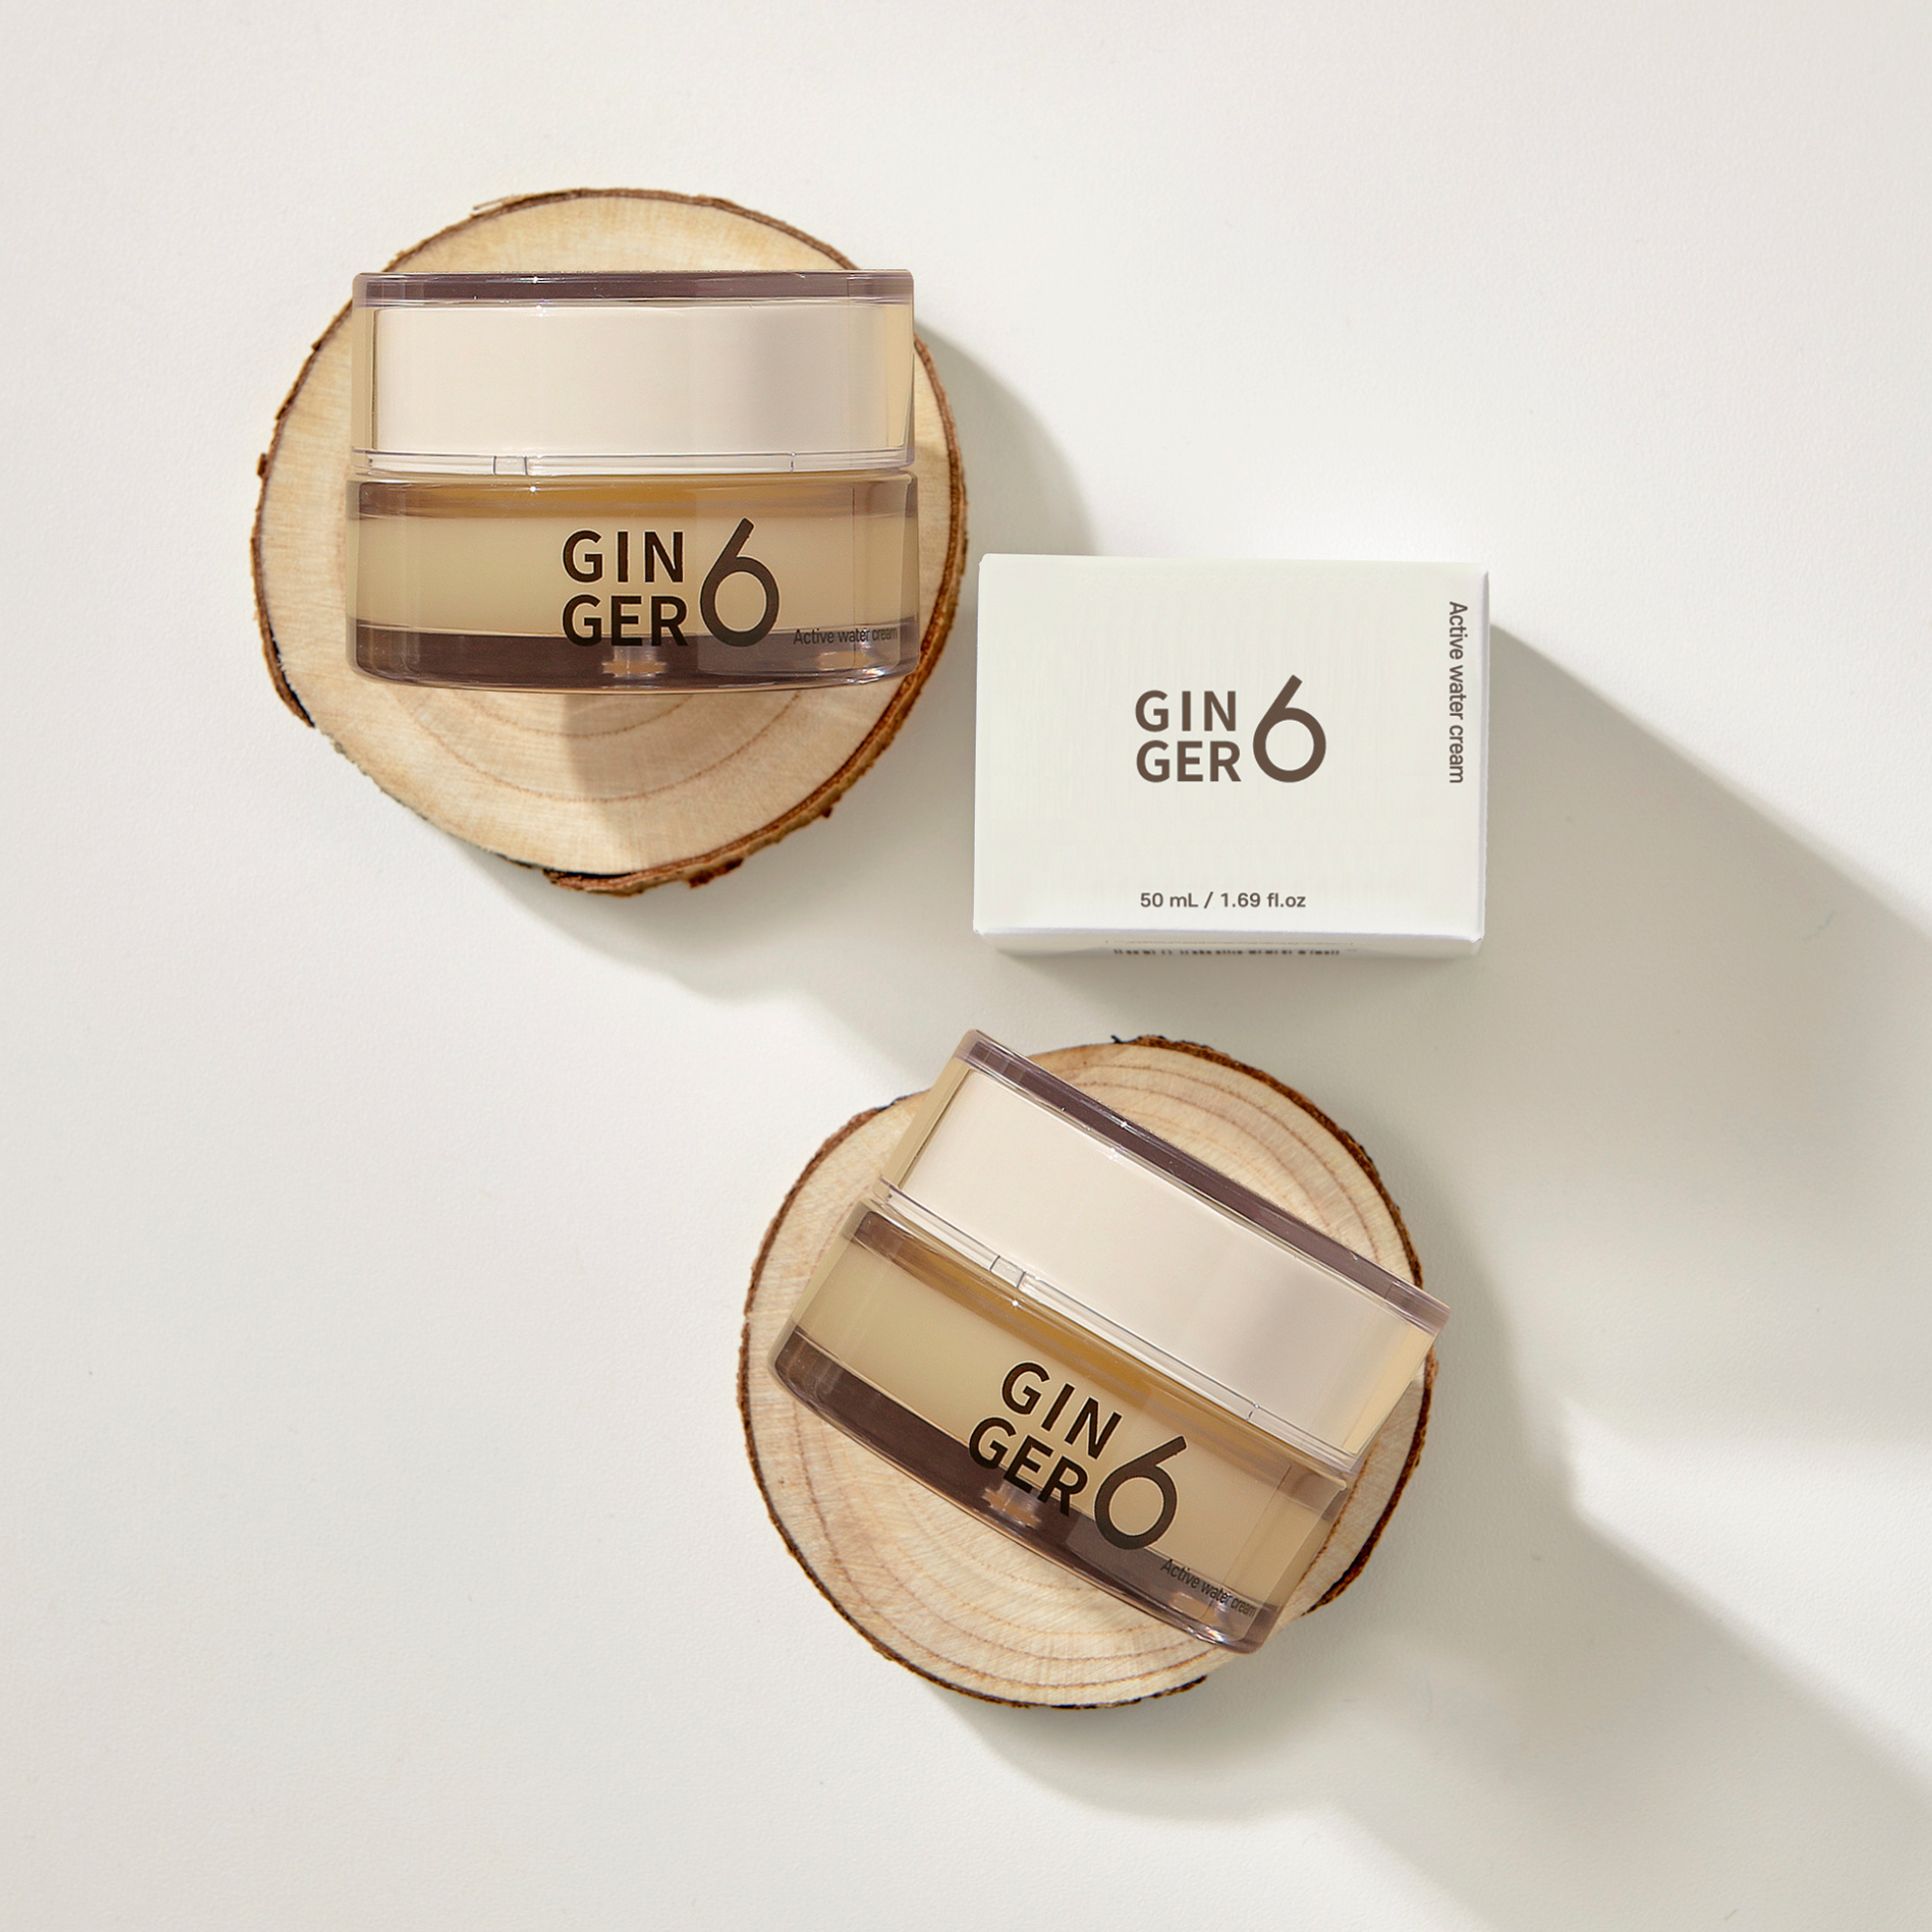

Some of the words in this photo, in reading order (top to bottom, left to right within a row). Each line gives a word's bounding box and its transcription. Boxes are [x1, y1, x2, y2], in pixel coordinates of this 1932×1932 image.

[562, 530, 684, 583] GIN
[700, 517, 779, 647] 6
[562, 594, 688, 647] GER
[793, 628, 834, 645] Active
[838, 627, 870, 643] water
[1449, 601, 1468, 660] Active
[1135, 690, 1236, 733] GIN
[1449, 664, 1467, 721] water
[1252, 674, 1326, 783] 6
[1449, 725, 1464, 783] cream
[1136, 740, 1242, 783] GER
[1140, 893, 1164, 907] 50
[1170, 893, 1198, 907] mL
[1220, 893, 1261, 907] 1.69
[1267, 893, 1307, 907] fl.oz
[1002, 1362, 1122, 1459] GIN
[969, 1417, 1088, 1517] GER
[1094, 1436, 1187, 1550] 6
[1161, 1559, 1200, 1588] Active
[1200, 1581, 1232, 1605] water
